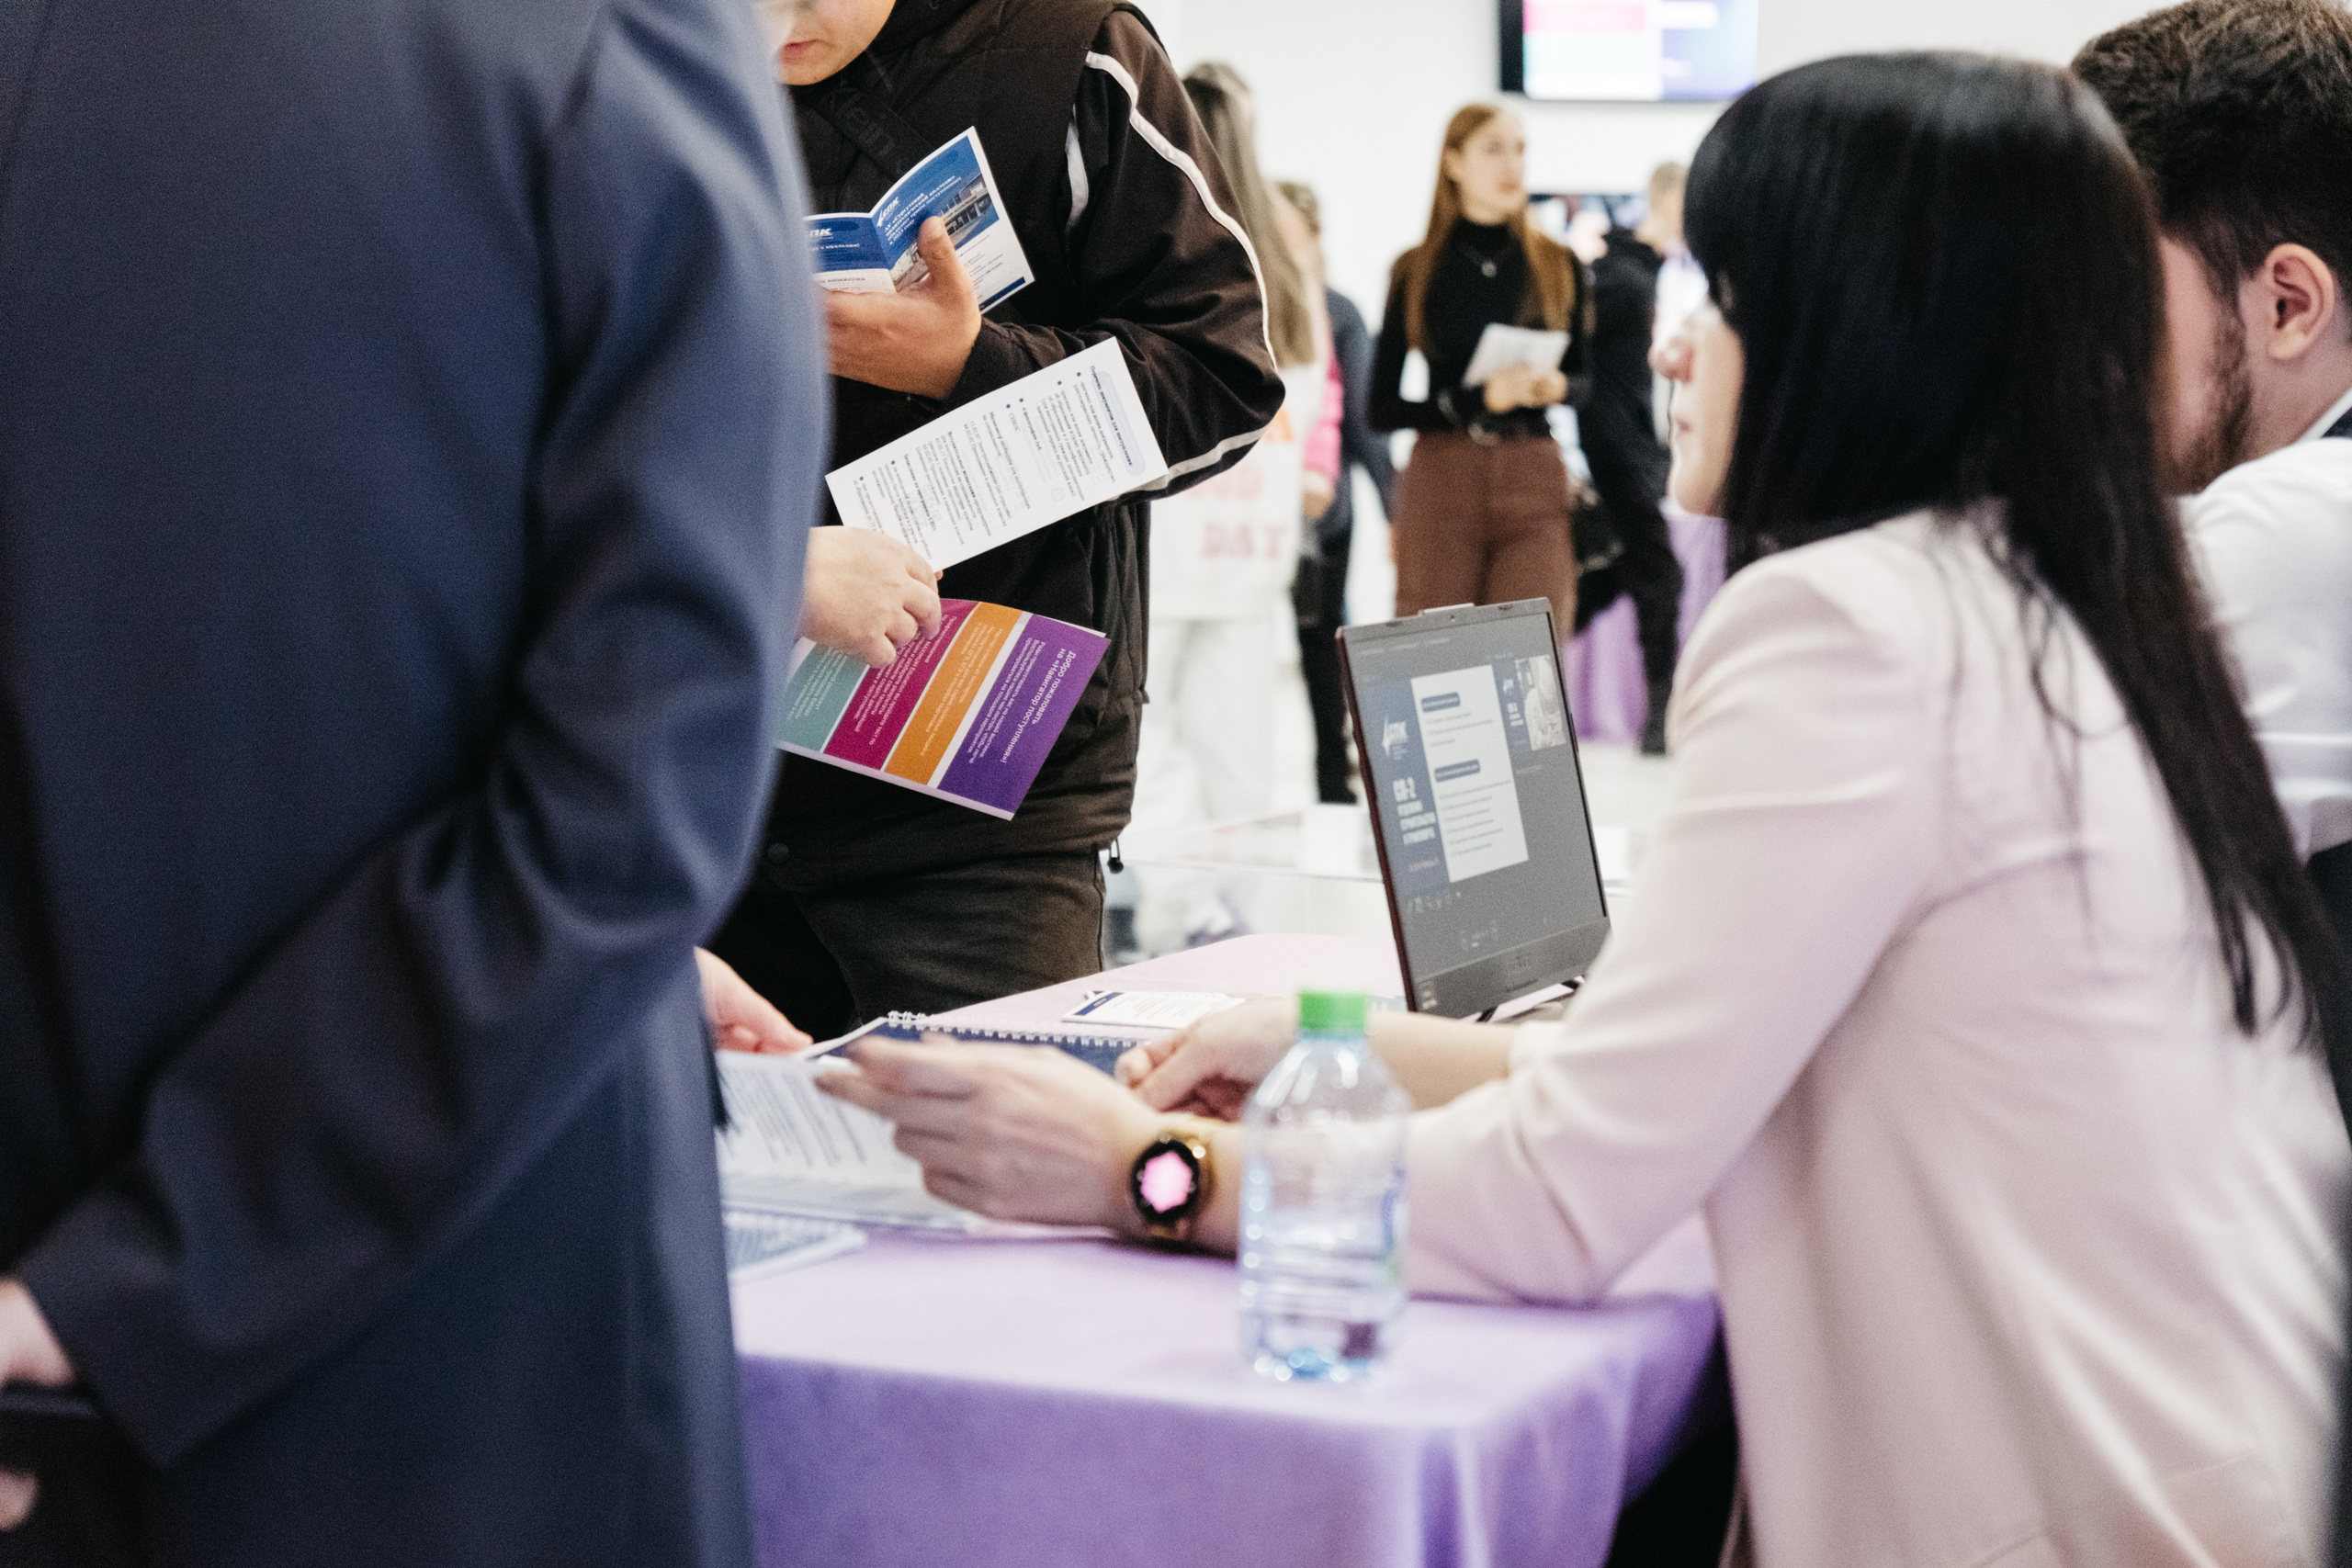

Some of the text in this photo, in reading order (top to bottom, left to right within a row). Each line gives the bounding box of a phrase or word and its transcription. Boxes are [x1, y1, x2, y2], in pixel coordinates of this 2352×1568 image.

[806, 228, 833, 237] ПК
[1089, 365, 1134, 468] Перечень документов для поступления:
[910, 638, 931, 668] MAXIMUM
[922, 614, 957, 664] Профтестирование
[1033, 640, 1046, 657] Рады
[1003, 636, 1034, 684] ориентироваться
[1011, 637, 1040, 683] Воспользуйтесь
[896, 665, 916, 694] Education
[1010, 654, 1038, 699] приветствовать
[1029, 658, 1061, 706] «Навигатор
[1029, 649, 1077, 727] Добро пожаловать
[984, 689, 1004, 718] площадке
[1001, 681, 1016, 702] нашим
[1004, 696, 1015, 709] вас
[870, 725, 883, 739] тест
[991, 715, 1005, 734] нашей
[998, 705, 1035, 764] поступления»!
[975, 730, 989, 750] чтобы
[977, 731, 996, 761] выставке.
[967, 747, 980, 764] легче
